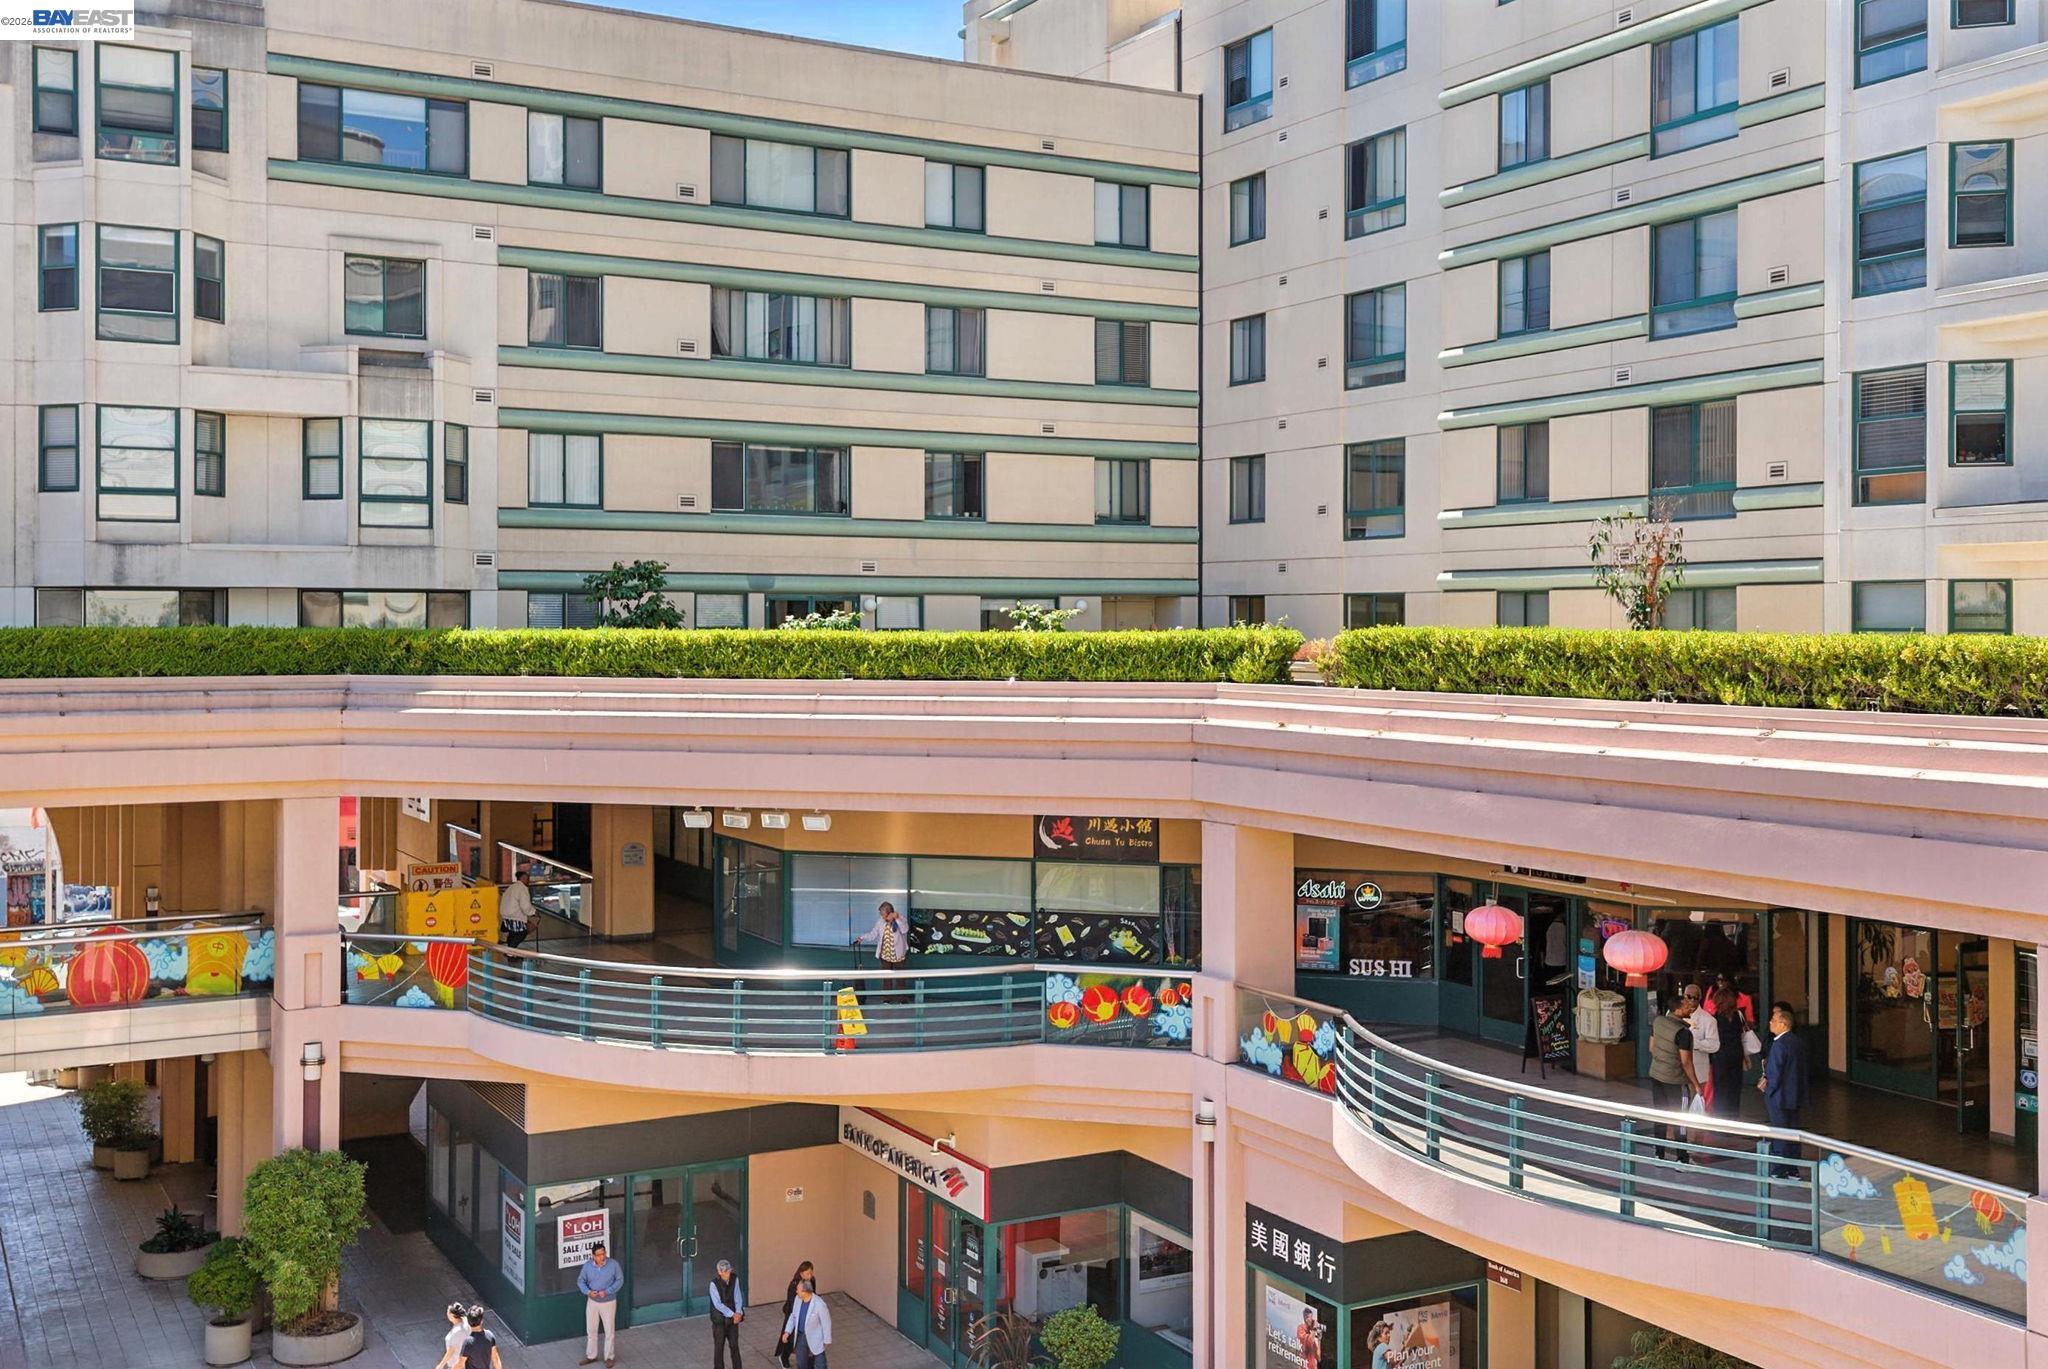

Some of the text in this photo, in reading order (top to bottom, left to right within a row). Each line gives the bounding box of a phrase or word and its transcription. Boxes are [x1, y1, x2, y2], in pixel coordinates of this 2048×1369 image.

[1085, 837, 1153, 848] Chuan Yu Bistro
[414, 866, 457, 875] CAUTION
[1297, 879, 1346, 899] Asahi
[843, 1123, 938, 1188] BANK OF AMERICA
[573, 1219, 603, 1234] LOH
[563, 1244, 580, 1255] SALE
[1251, 1219, 1336, 1284] 美國銀行
[1268, 1324, 1303, 1353] Let's talk
[1268, 1341, 1310, 1368] retirement
[1387, 1344, 1435, 1363] Plan your
